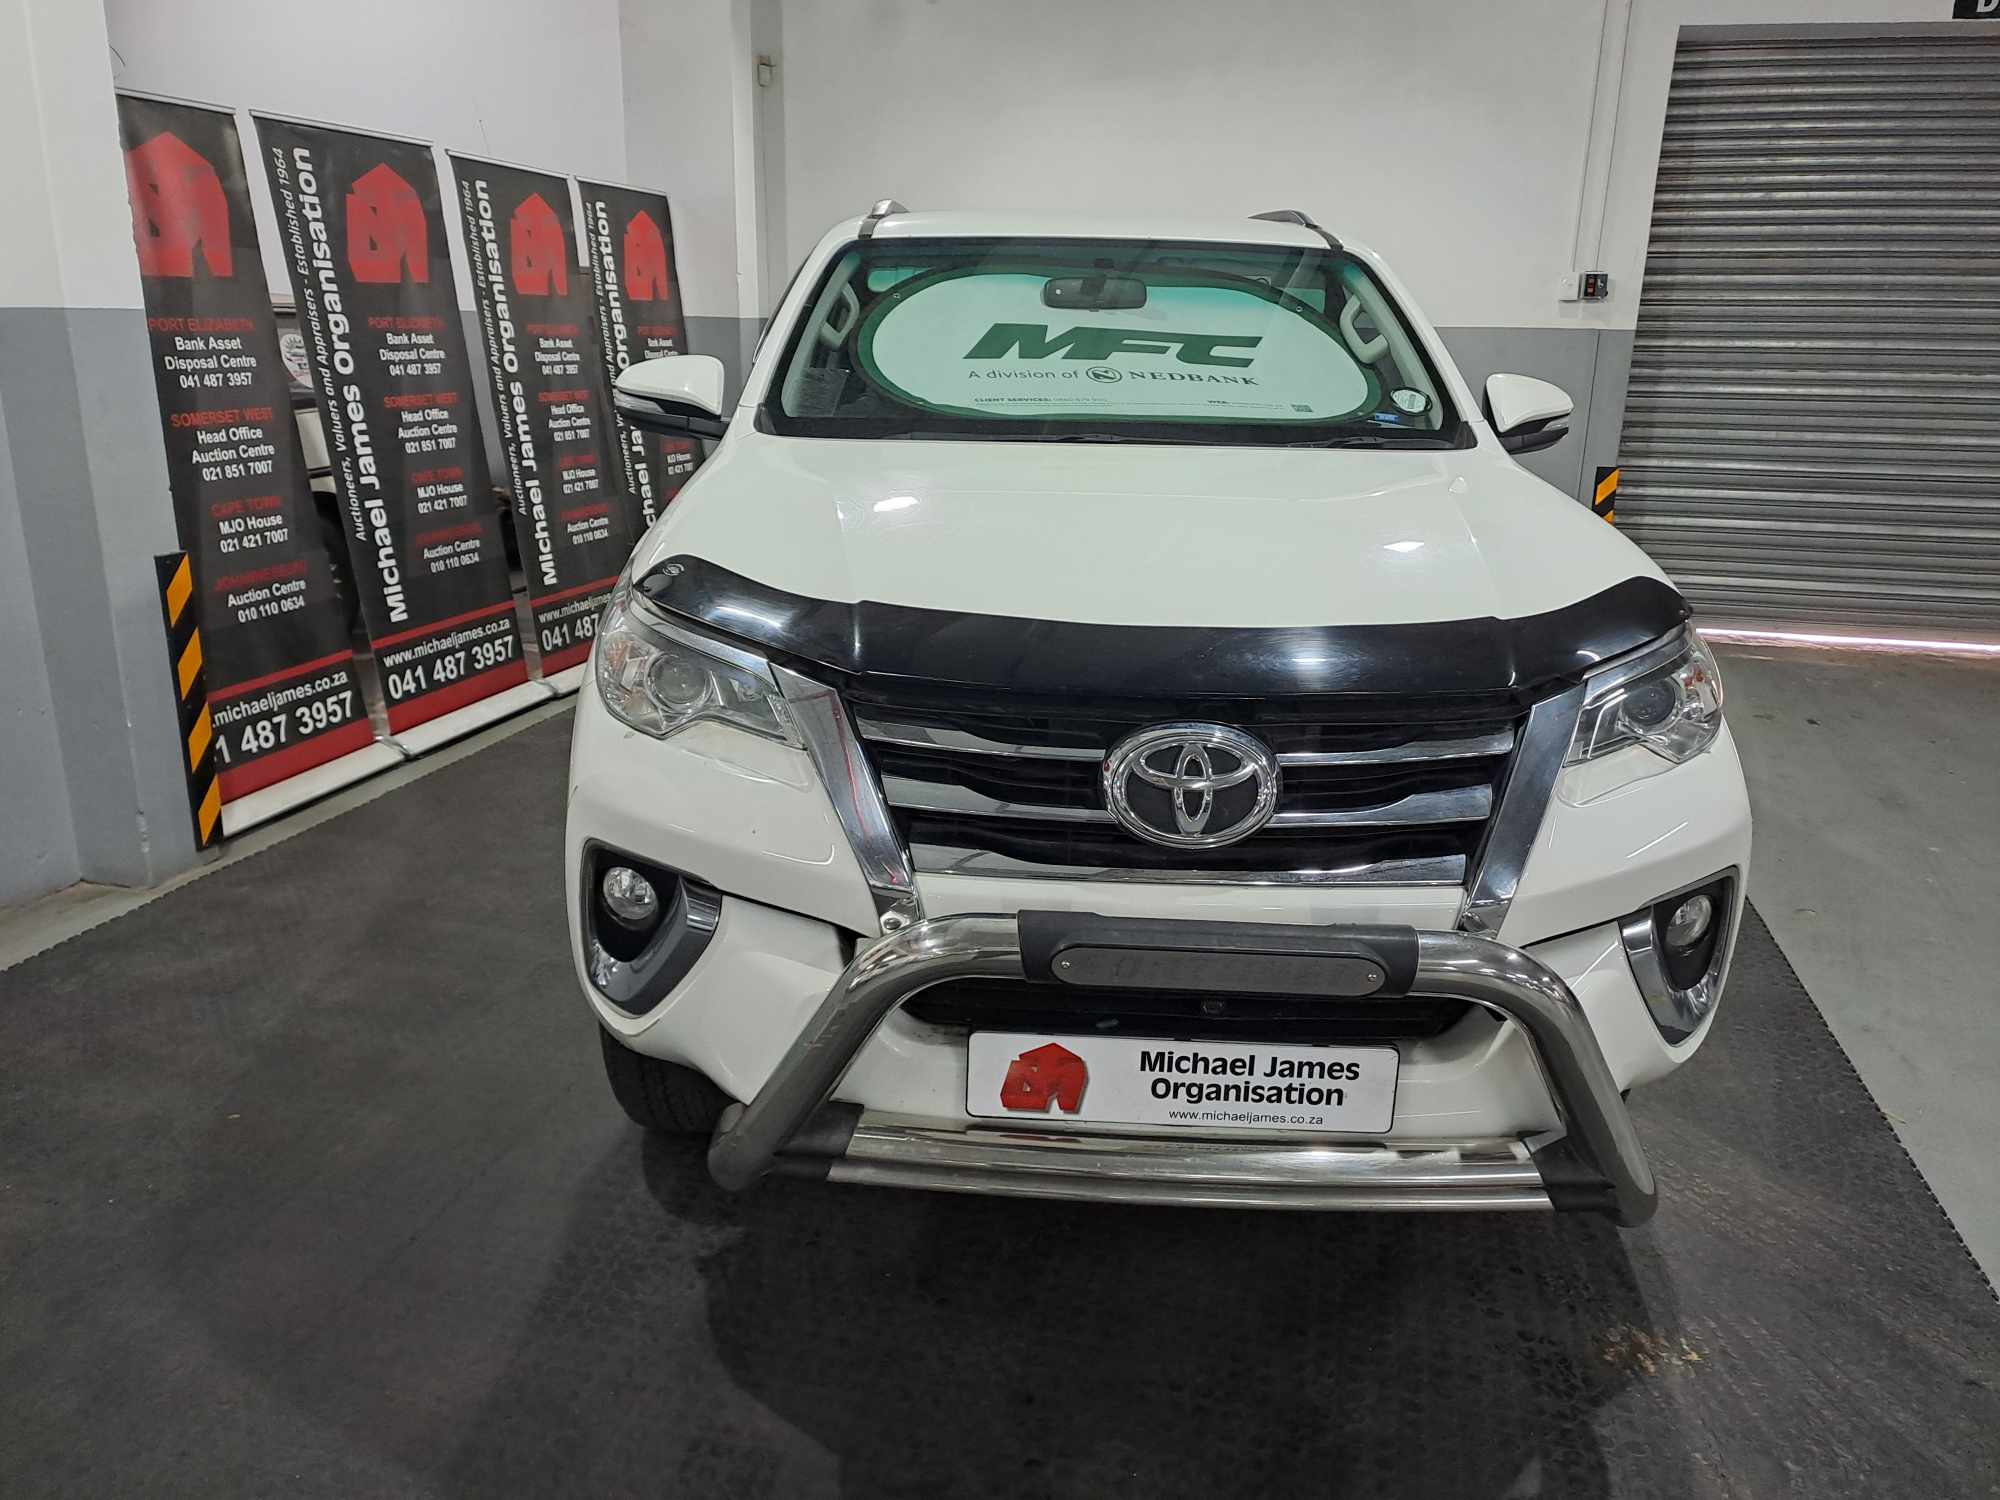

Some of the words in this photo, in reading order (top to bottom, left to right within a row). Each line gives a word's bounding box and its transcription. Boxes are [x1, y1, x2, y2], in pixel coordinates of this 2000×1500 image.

[272, 146, 291, 186] 1964
[280, 189, 309, 276] Established
[293, 147, 355, 376] Organisation
[467, 213, 487, 288] Established
[475, 179, 519, 373] Organisation
[595, 201, 629, 370] Organisation
[303, 288, 330, 366] Appraisers
[386, 333, 409, 345] Bank
[481, 299, 502, 367] Appraisers
[175, 336, 206, 351] Bank
[209, 336, 242, 350] Asset
[379, 348, 418, 362] Disposal
[419, 348, 446, 359] Centre
[963, 323, 1263, 368] MFC
[164, 355, 218, 372] Disposal
[221, 354, 257, 368] Centre
[389, 364, 405, 376] 041
[406, 363, 421, 375] 487
[968, 370, 981, 379] A
[986, 368, 1056, 380] division
[1059, 369, 1079, 380] of
[1129, 370, 1259, 386] NEDBANK
[179, 375, 200, 389] 041
[203, 374, 223, 387] 487
[226, 373, 252, 386] 3957
[317, 367, 335, 397] and
[494, 368, 505, 392] and
[328, 399, 347, 452] Valuers
[401, 410, 423, 422] Head
[499, 395, 513, 439] Valuers
[510, 381, 536, 472] James
[197, 428, 226, 444] Head
[229, 426, 263, 441] Office
[343, 384, 381, 490] James
[398, 427, 430, 439] Auction
[431, 424, 458, 435] Centre
[192, 448, 237, 464] Auction
[239, 444, 275, 458] Centre
[405, 442, 420, 454] 021
[421, 440, 437, 451] 851
[202, 466, 222, 481] 021
[225, 463, 245, 478] 851
[248, 460, 273, 475] 7007
[341, 456, 367, 542] Auctioneers,
[417, 486, 436, 499] MJO
[436, 482, 464, 495] House
[634, 463, 657, 528] chael
[417, 501, 433, 514] 021
[433, 499, 448, 511] 421
[219, 518, 244, 535] MJO
[246, 514, 282, 530] House
[525, 479, 558, 586] Michael
[220, 539, 240, 553] 021
[242, 534, 262, 549] 421
[264, 528, 289, 544] 7007
[423, 544, 453, 559] Auction
[454, 538, 480, 552] Centre
[364, 498, 408, 623] Michael
[227, 588, 270, 608] Auction
[272, 580, 306, 596] Centre
[238, 608, 258, 623] 010
[259, 602, 278, 618] 110
[281, 595, 305, 612] 0634
[383, 618, 510, 668] www.michaeljames.co.za
[541, 623, 570, 651] 041
[574, 613, 599, 639] 487
[388, 664, 427, 700] 041
[432, 651, 466, 684] 487
[471, 635, 514, 671] 3957
[212, 670, 349, 728] .michaeljames.co.za
[240, 713, 288, 754] 487
[295, 690, 353, 735] 3957
[1139, 1051, 1255, 1076] Michael
[1263, 1055, 1360, 1081] James
[1150, 1077, 1345, 1106] Organisation
[1168, 1108, 1324, 1126] www.michaeljames.co.za
